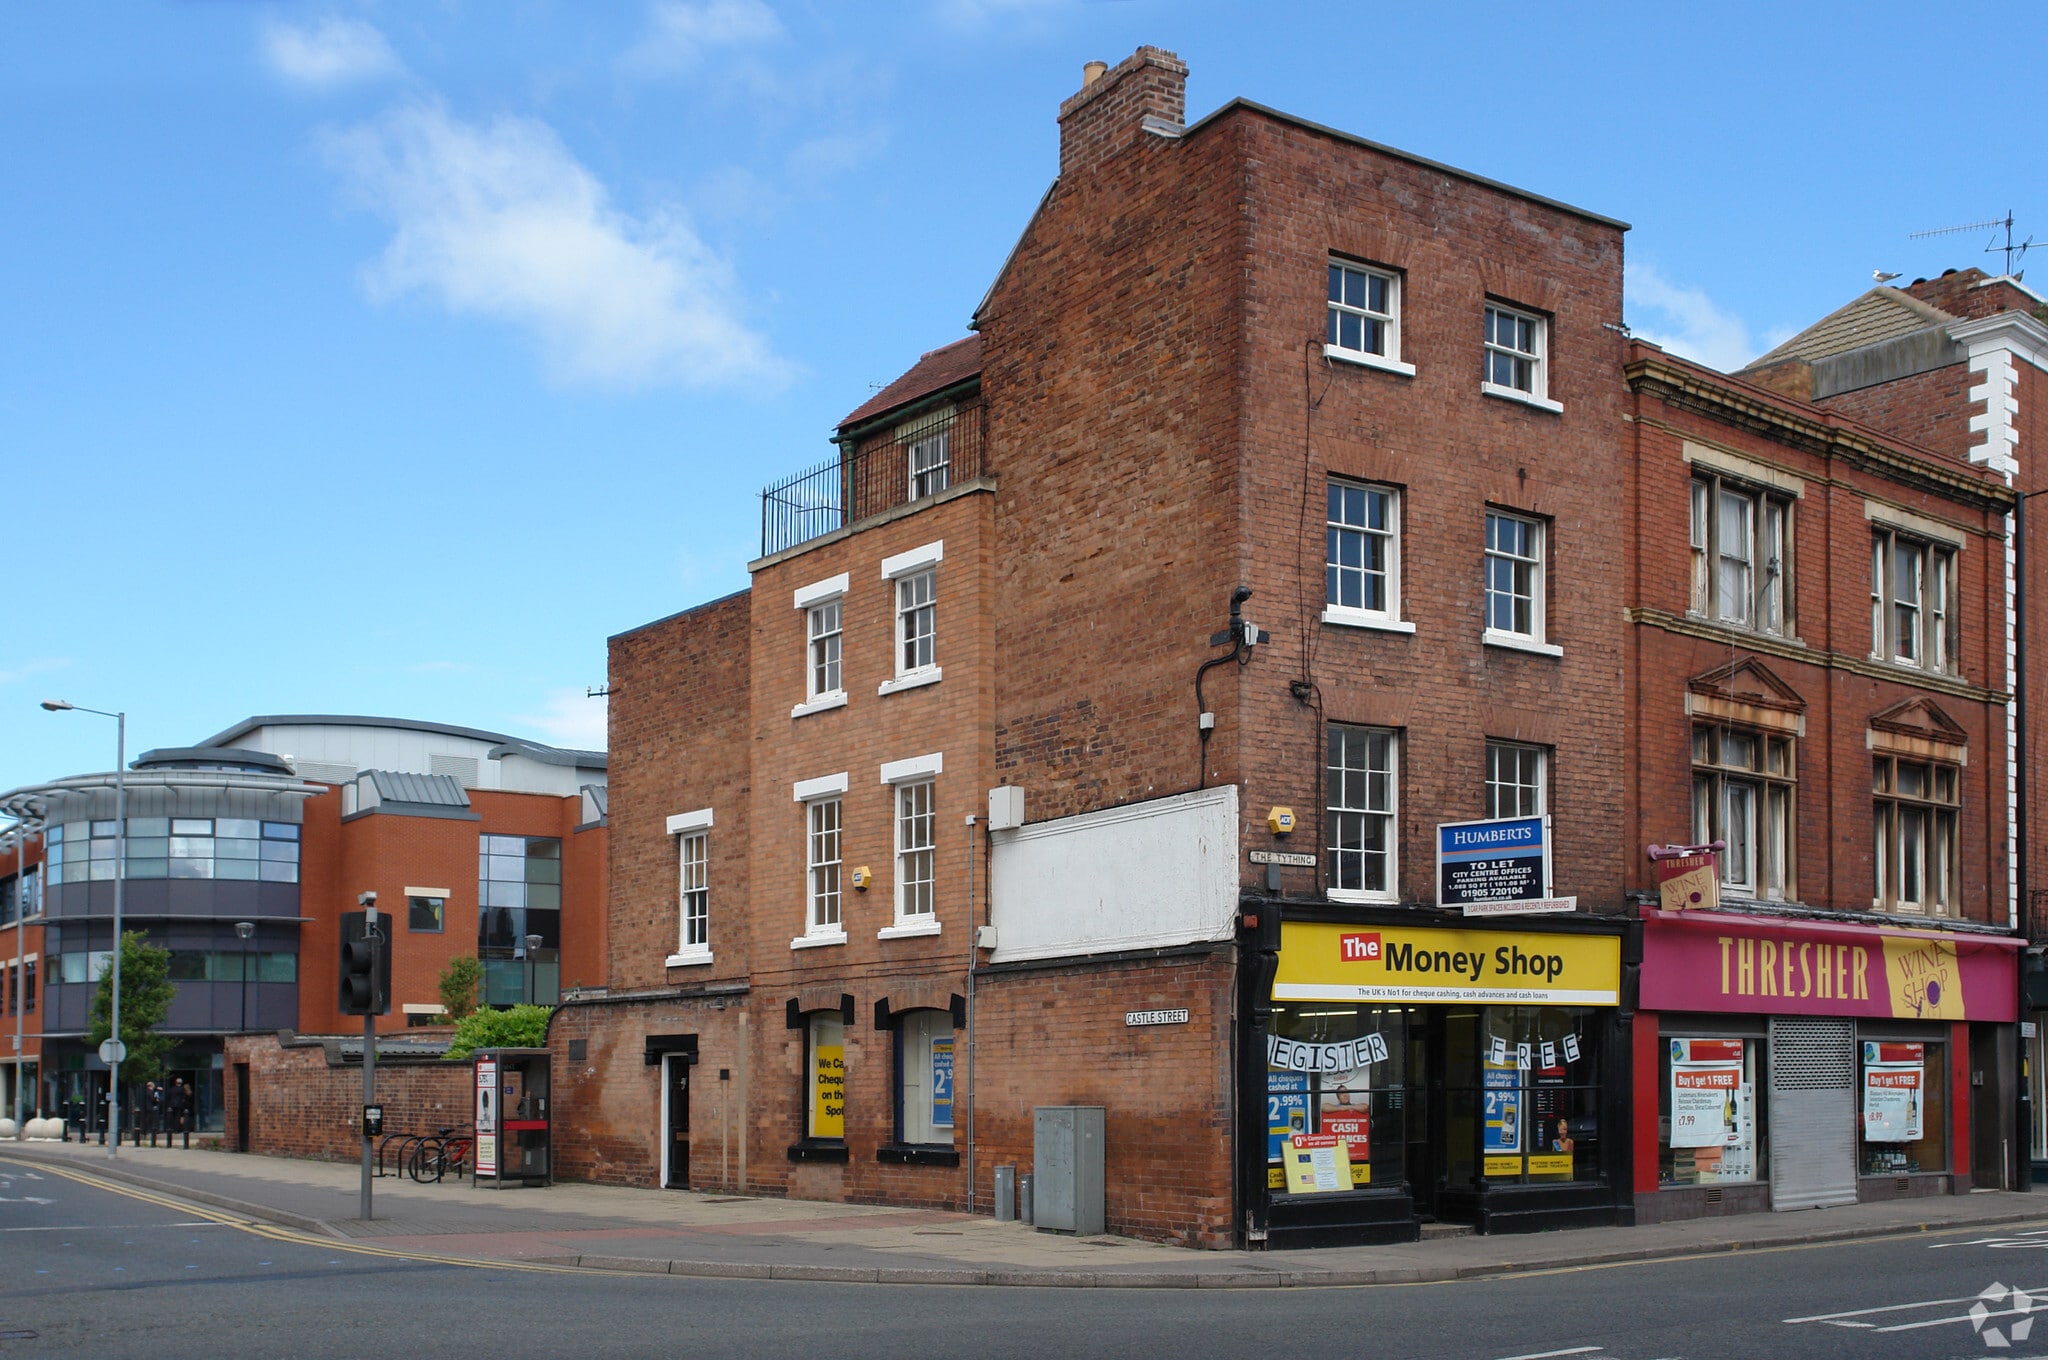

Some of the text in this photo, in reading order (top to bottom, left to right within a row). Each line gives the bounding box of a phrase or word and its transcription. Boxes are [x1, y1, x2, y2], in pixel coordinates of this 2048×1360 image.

[1454, 827, 1532, 845] HUMBERTS
[1255, 852, 1312, 865] THE TYTHING
[1666, 856, 1705, 868] THRESHER
[1470, 860, 1515, 870] TO LET
[1470, 869, 1499, 878] CENTRE
[1501, 867, 1532, 875] OFFICES
[1665, 872, 1704, 894] WINE
[1461, 886, 1523, 898] 01905 720104
[1670, 884, 1708, 905] SHOP
[1343, 937, 1563, 983] The Money Shop
[1897, 940, 1946, 980] WINE
[1718, 937, 1869, 1000] THRESHER
[1358, 988, 1370, 996] The
[1387, 988, 1400, 997] No1
[1401, 988, 1412, 997] for
[1412, 990, 1436, 998] cheque
[1436, 990, 1462, 999] cashing,
[1462, 990, 1477, 998] cash
[1478, 990, 1506, 999] advances
[1506, 990, 1518, 999] and
[1519, 991, 1532, 999] cash
[1532, 991, 1549, 1000] loans
[1902, 968, 1948, 1009] SHOP
[1127, 1010, 1187, 1025] CASTLE STREET
[1492, 1036, 1579, 1068] FREE
[819, 1058, 831, 1068] We
[1279, 1075, 1303, 1084] cheques
[1495, 1072, 1517, 1081] cheques
[1678, 1074, 1733, 1087] Buy 1 get 1 FREE
[1870, 1076, 1881, 1087] Buy
[1895, 1075, 1899, 1085] 1
[1899, 1075, 1915, 1085] FREE
[1331, 1123, 1358, 1133] CASH
[1295, 1135, 1307, 1147] 0%
[1337, 1134, 1367, 1143] ANCES
